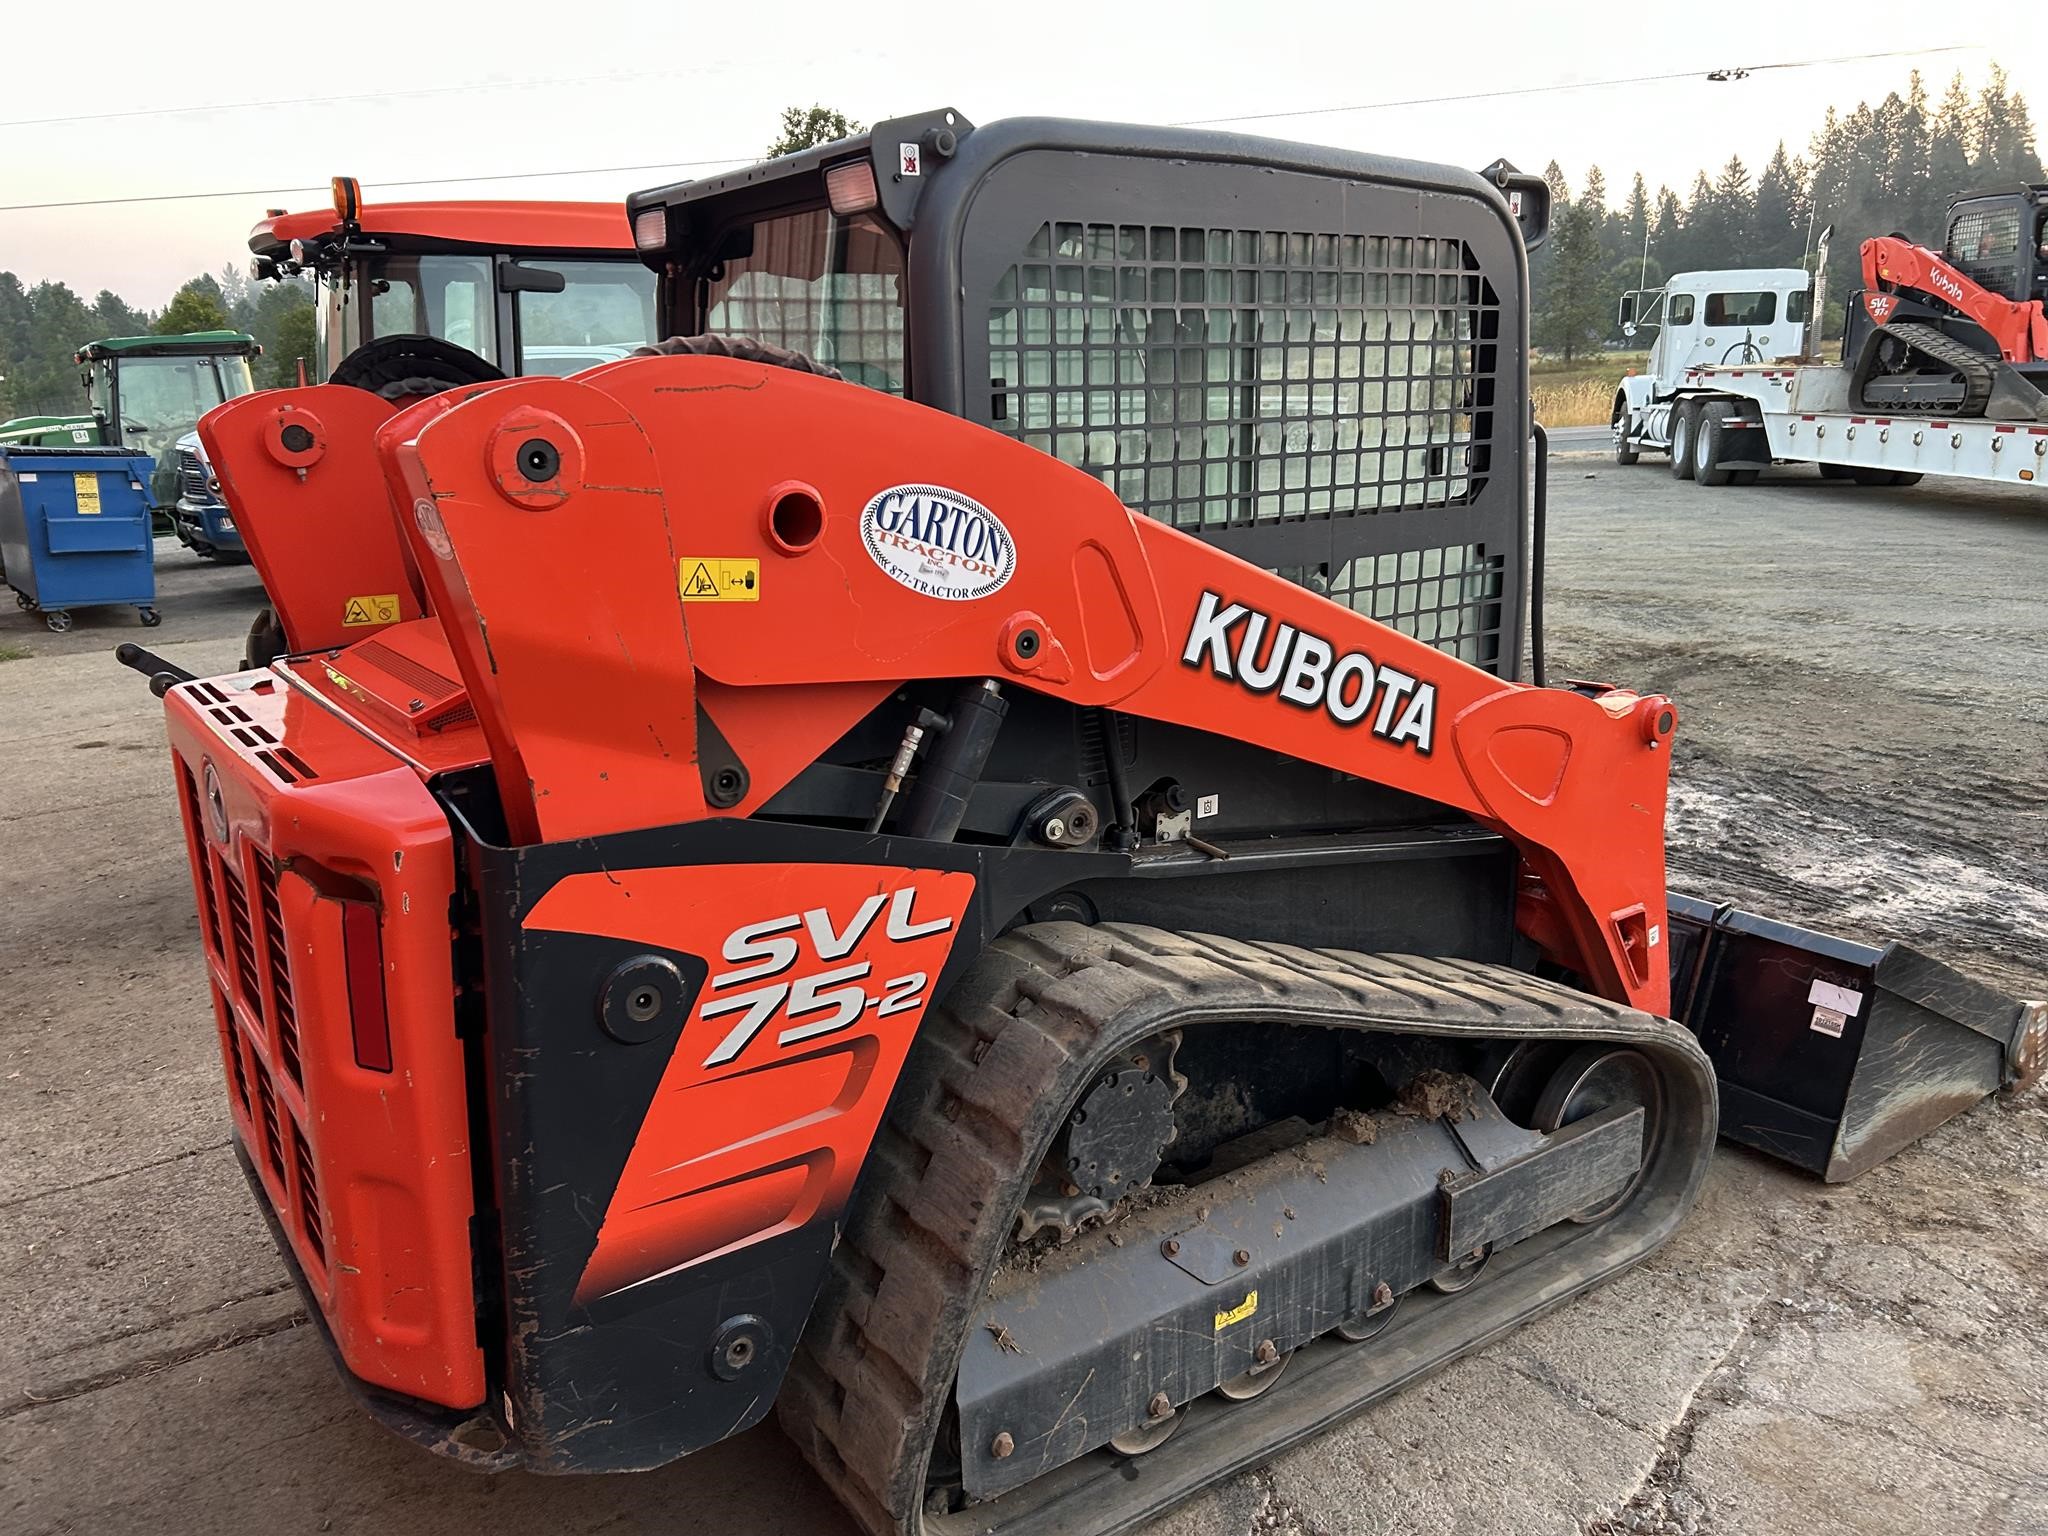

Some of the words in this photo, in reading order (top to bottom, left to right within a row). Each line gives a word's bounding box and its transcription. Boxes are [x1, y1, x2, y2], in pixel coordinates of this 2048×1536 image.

[1869, 298, 1889, 309] SVL
[1930, 266, 1963, 302] Kubota
[873, 529, 998, 579] TRACTOR
[875, 492, 1006, 566] GARTON
[889, 565, 970, 599] 877-TRACTOR
[927, 558, 944, 569] INC.
[1182, 591, 1436, 753] KUBOTA
[711, 886, 953, 990] SVL
[699, 961, 928, 1068] 75-2
